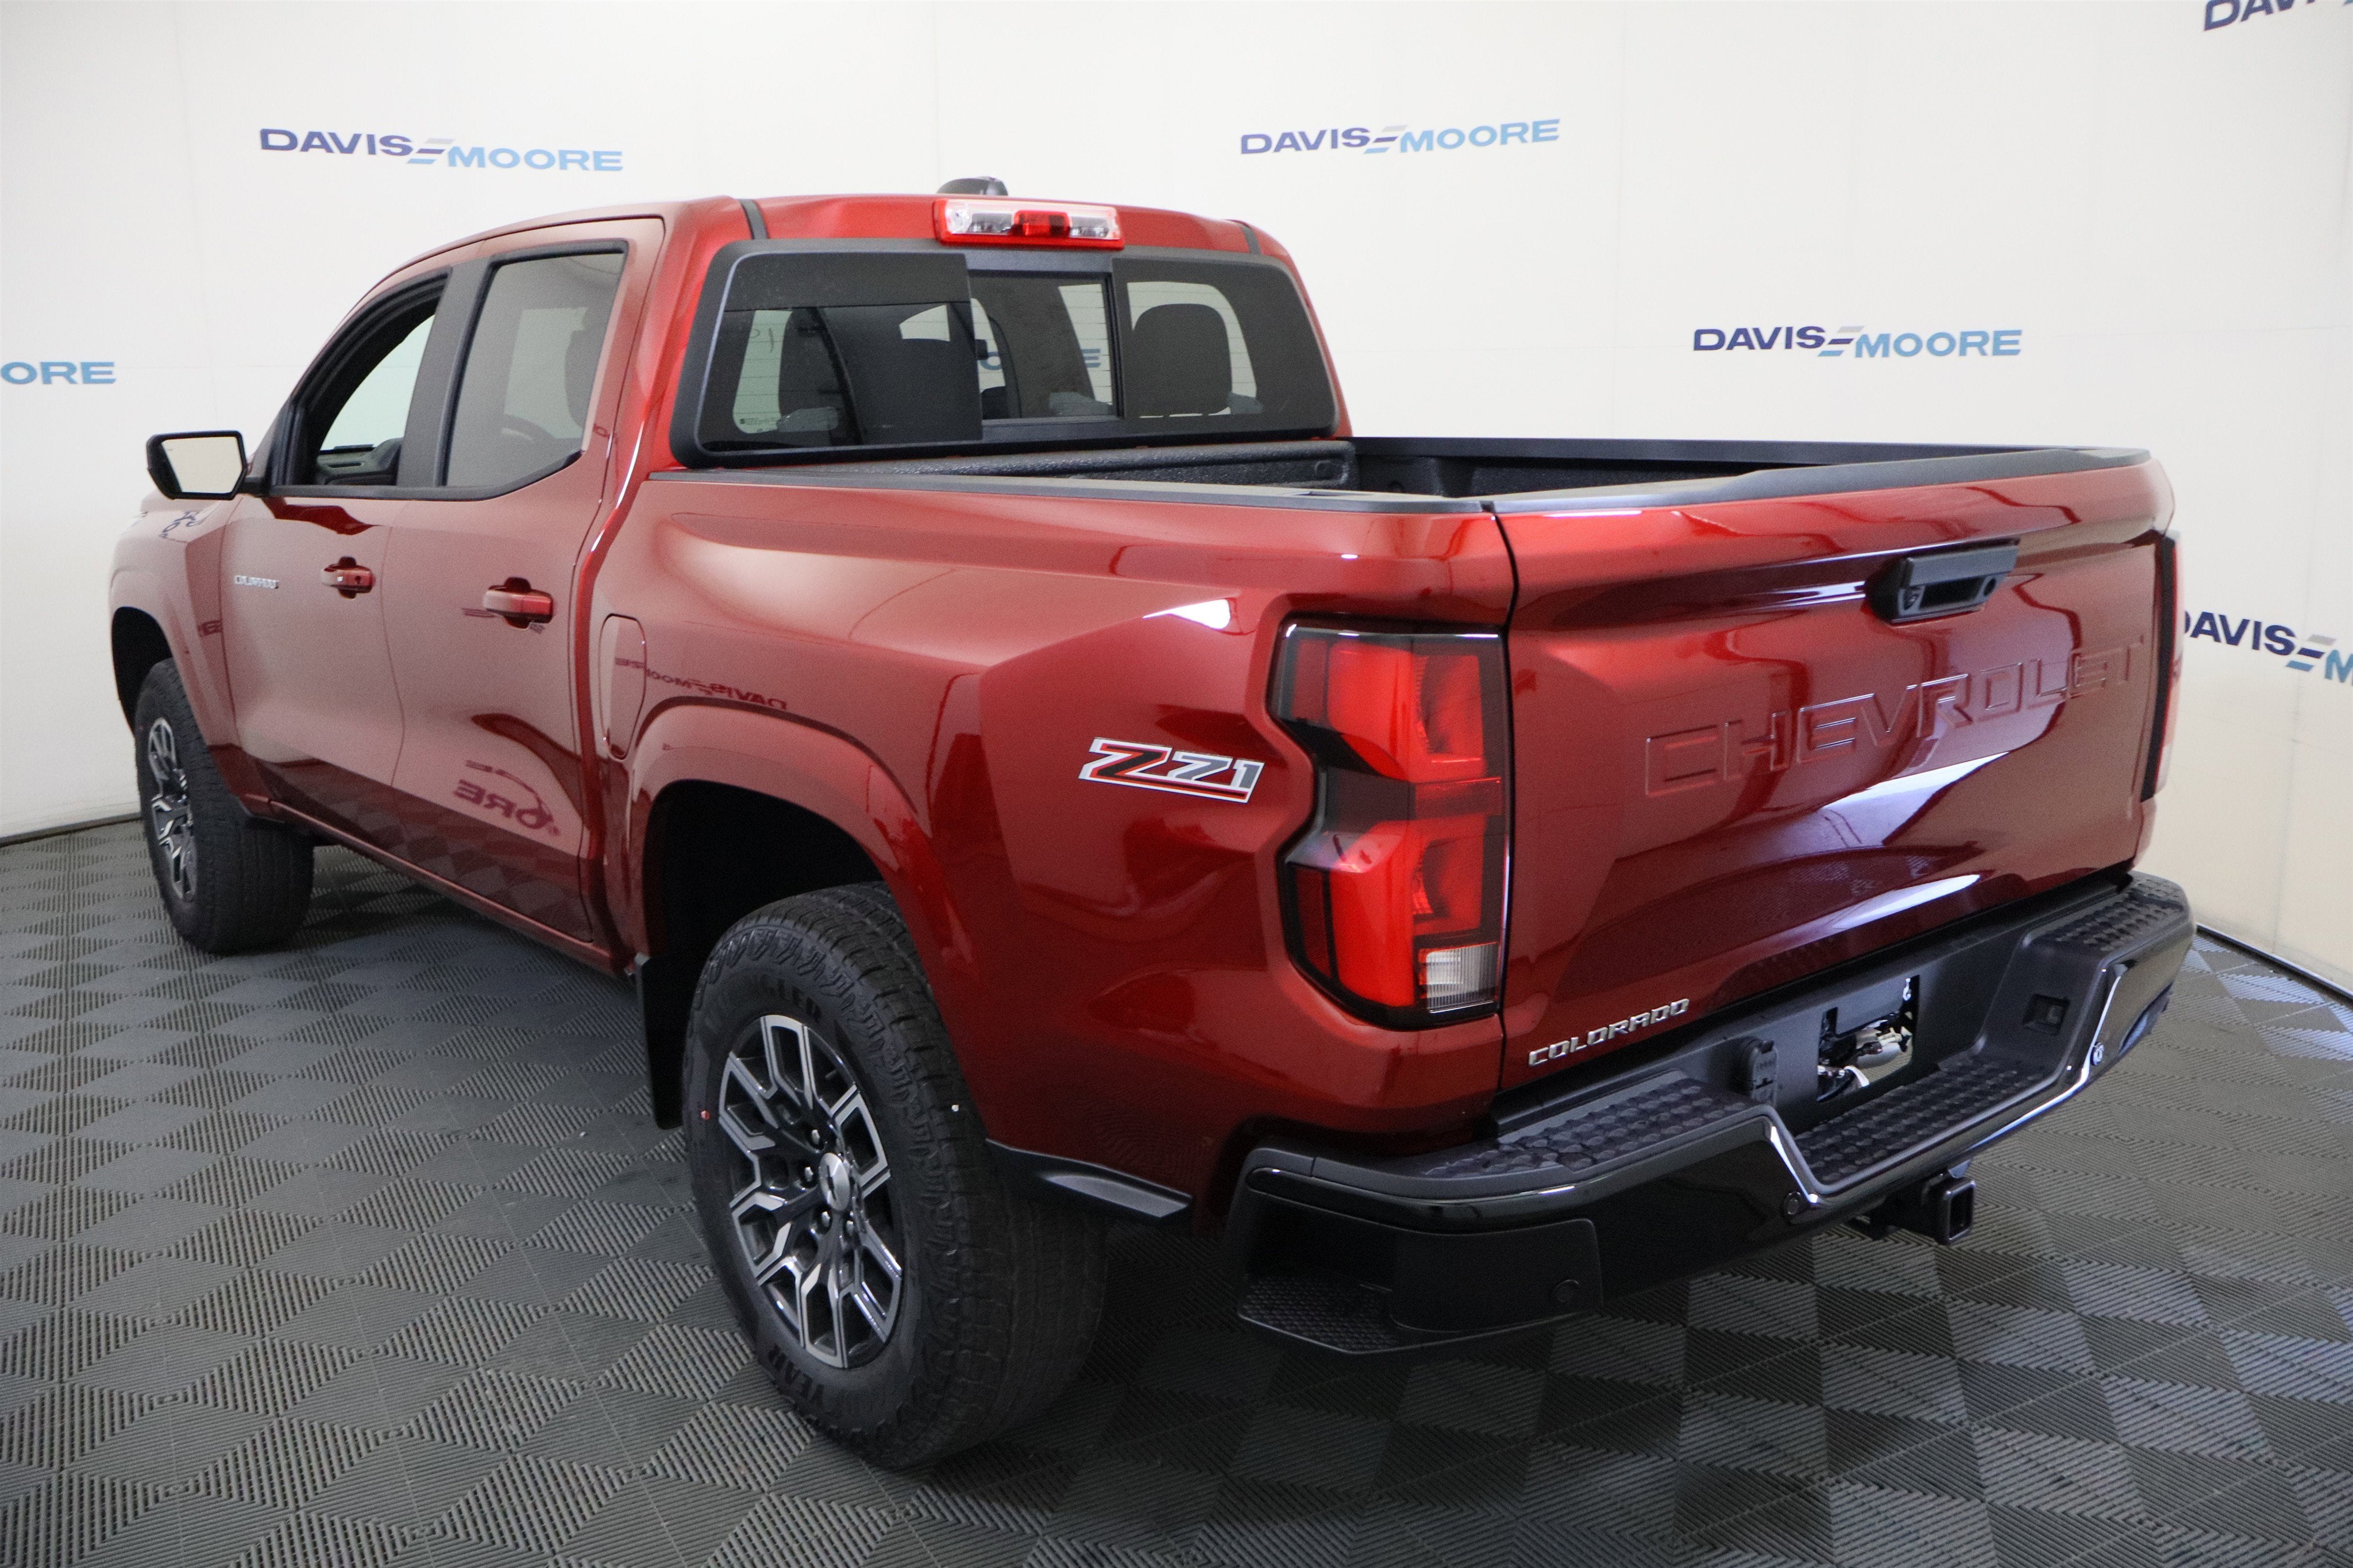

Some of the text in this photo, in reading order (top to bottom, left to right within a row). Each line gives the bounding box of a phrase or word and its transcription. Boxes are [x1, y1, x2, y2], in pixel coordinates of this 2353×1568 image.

[260, 128, 623, 172] DAVIS MOORE
[1240, 118, 1560, 155] DAVIS MOORE
[1692, 325, 2023, 358] DAVIS MOORE
[2184, 610, 2297, 656] AVIS
[1645, 635, 2144, 797] CHEVROLET
[1078, 736, 1266, 804] Z71
[1528, 998, 1690, 1067] COLORADO
